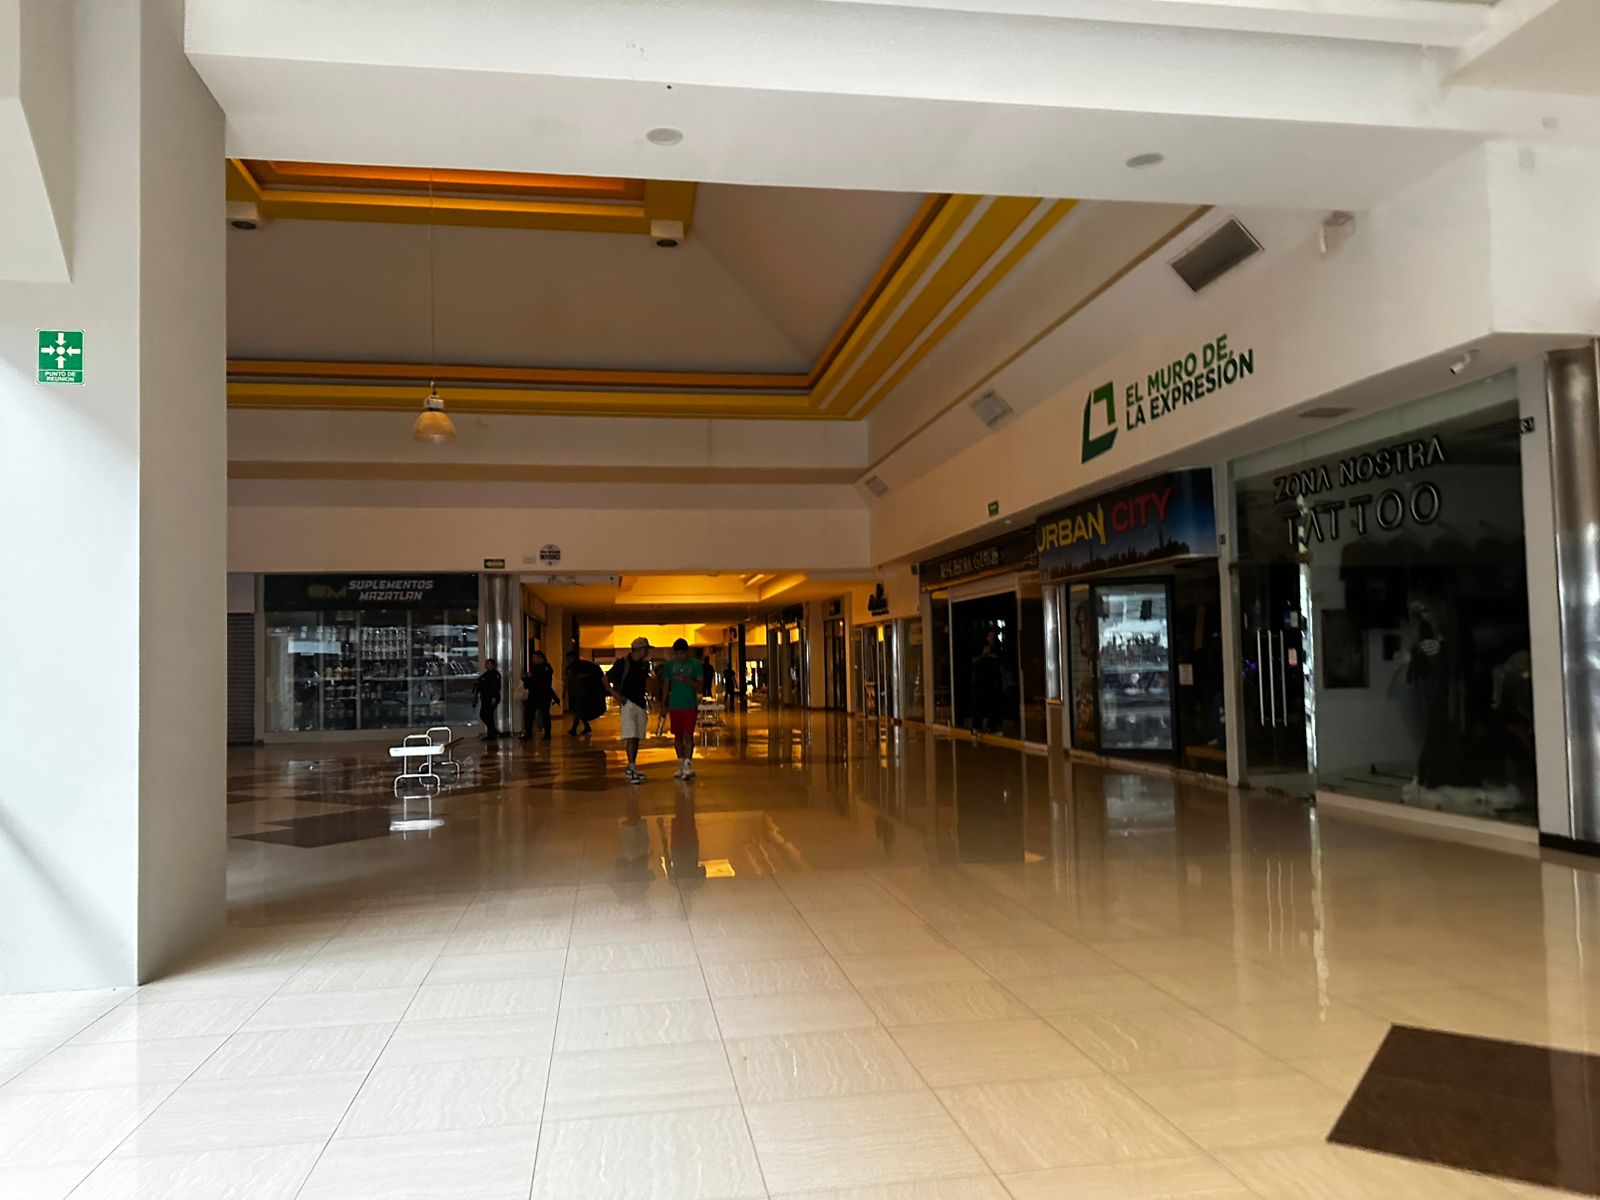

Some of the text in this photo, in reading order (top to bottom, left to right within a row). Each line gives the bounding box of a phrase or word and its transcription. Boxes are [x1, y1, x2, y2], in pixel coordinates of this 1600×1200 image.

[1126, 333, 1228, 407] EL MURO DE
[1126, 348, 1254, 431] LA EXPRESIÓN
[1273, 433, 1447, 503] ZONA NOSTRA
[1111, 484, 1174, 533] CITY
[1282, 481, 1442, 547] TATTOO
[348, 579, 435, 591] SUPLEMENTOS
[358, 591, 424, 602] MAZATLAN
